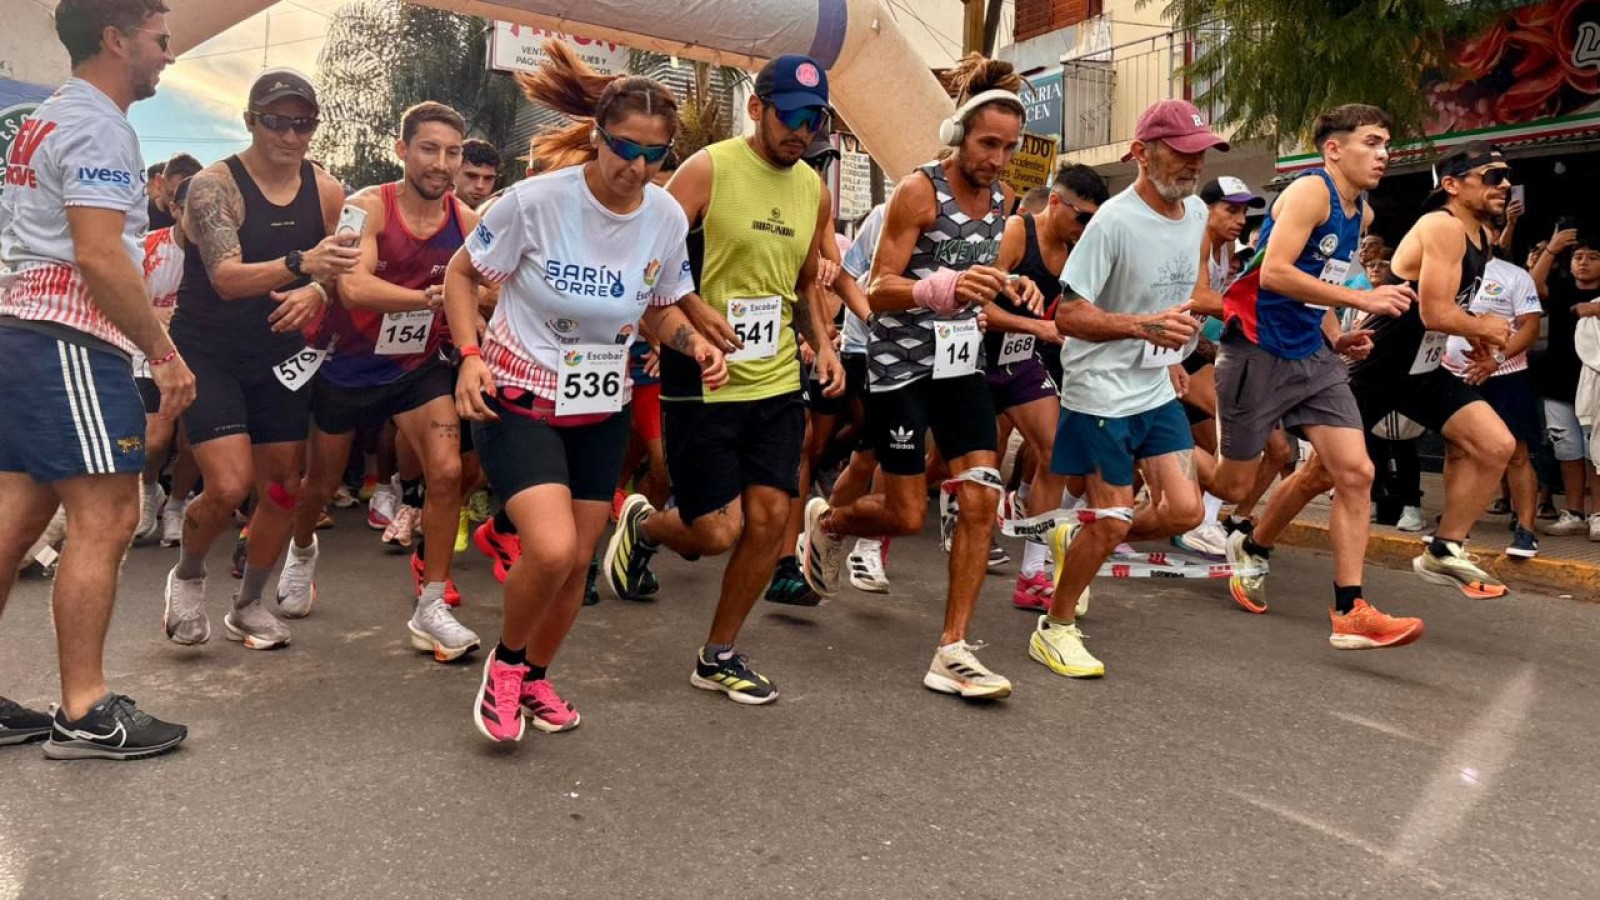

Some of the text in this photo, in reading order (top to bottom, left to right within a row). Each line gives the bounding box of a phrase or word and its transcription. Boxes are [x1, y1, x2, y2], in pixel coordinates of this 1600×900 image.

[1026, 101, 1050, 122] CEN
[1020, 137, 1050, 158] ADO
[934, 239, 1000, 264] KENY
[750, 302, 779, 311] Escobar
[385, 324, 427, 344] 154
[733, 320, 774, 345] 541
[586, 351, 624, 361] Escobar
[946, 341, 971, 365] 14
[1003, 337, 1034, 356] 668
[279, 351, 318, 382] 579
[563, 371, 620, 399] 536
